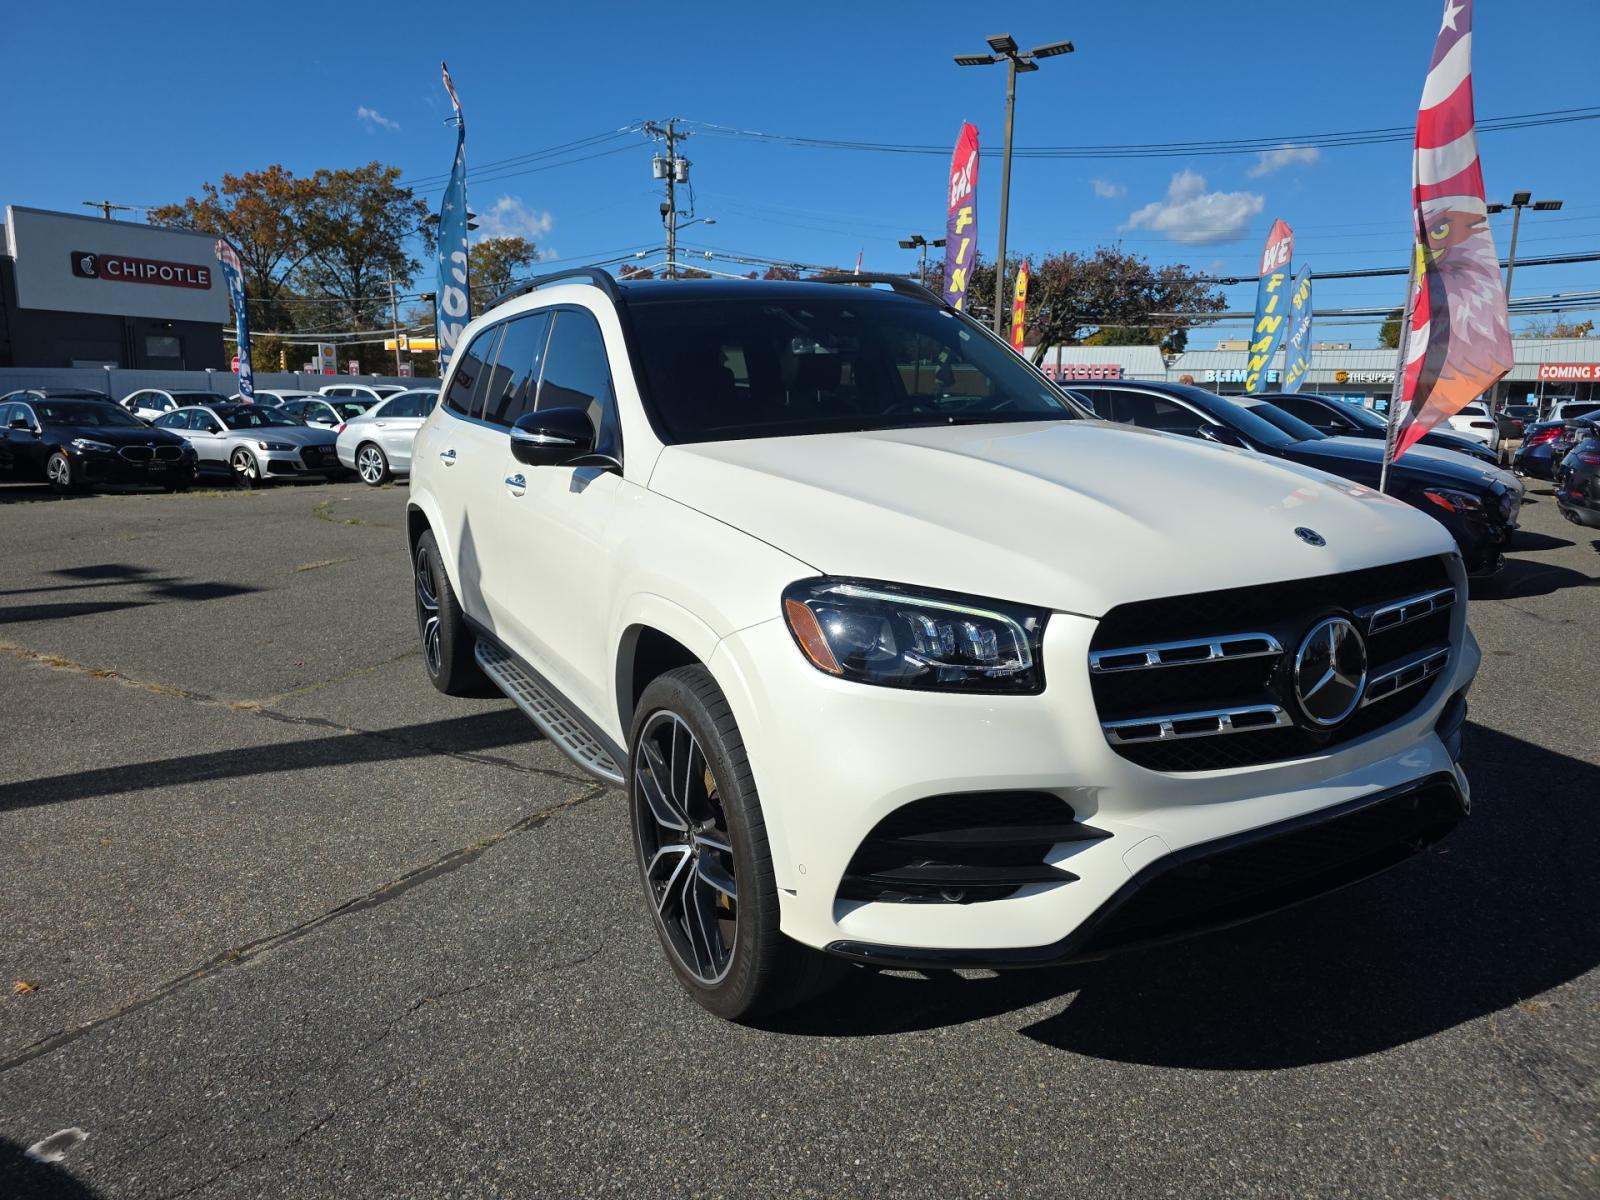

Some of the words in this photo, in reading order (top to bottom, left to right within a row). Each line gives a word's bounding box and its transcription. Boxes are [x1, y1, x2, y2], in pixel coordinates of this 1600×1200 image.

[1262, 237, 1291, 273] WE
[107, 260, 208, 284] CHIPOTLE
[1204, 369, 1277, 382] BLIME
[1350, 372, 1366, 381] THE
[1368, 372, 1387, 382] UPS
[1541, 366, 1590, 378] COMING
